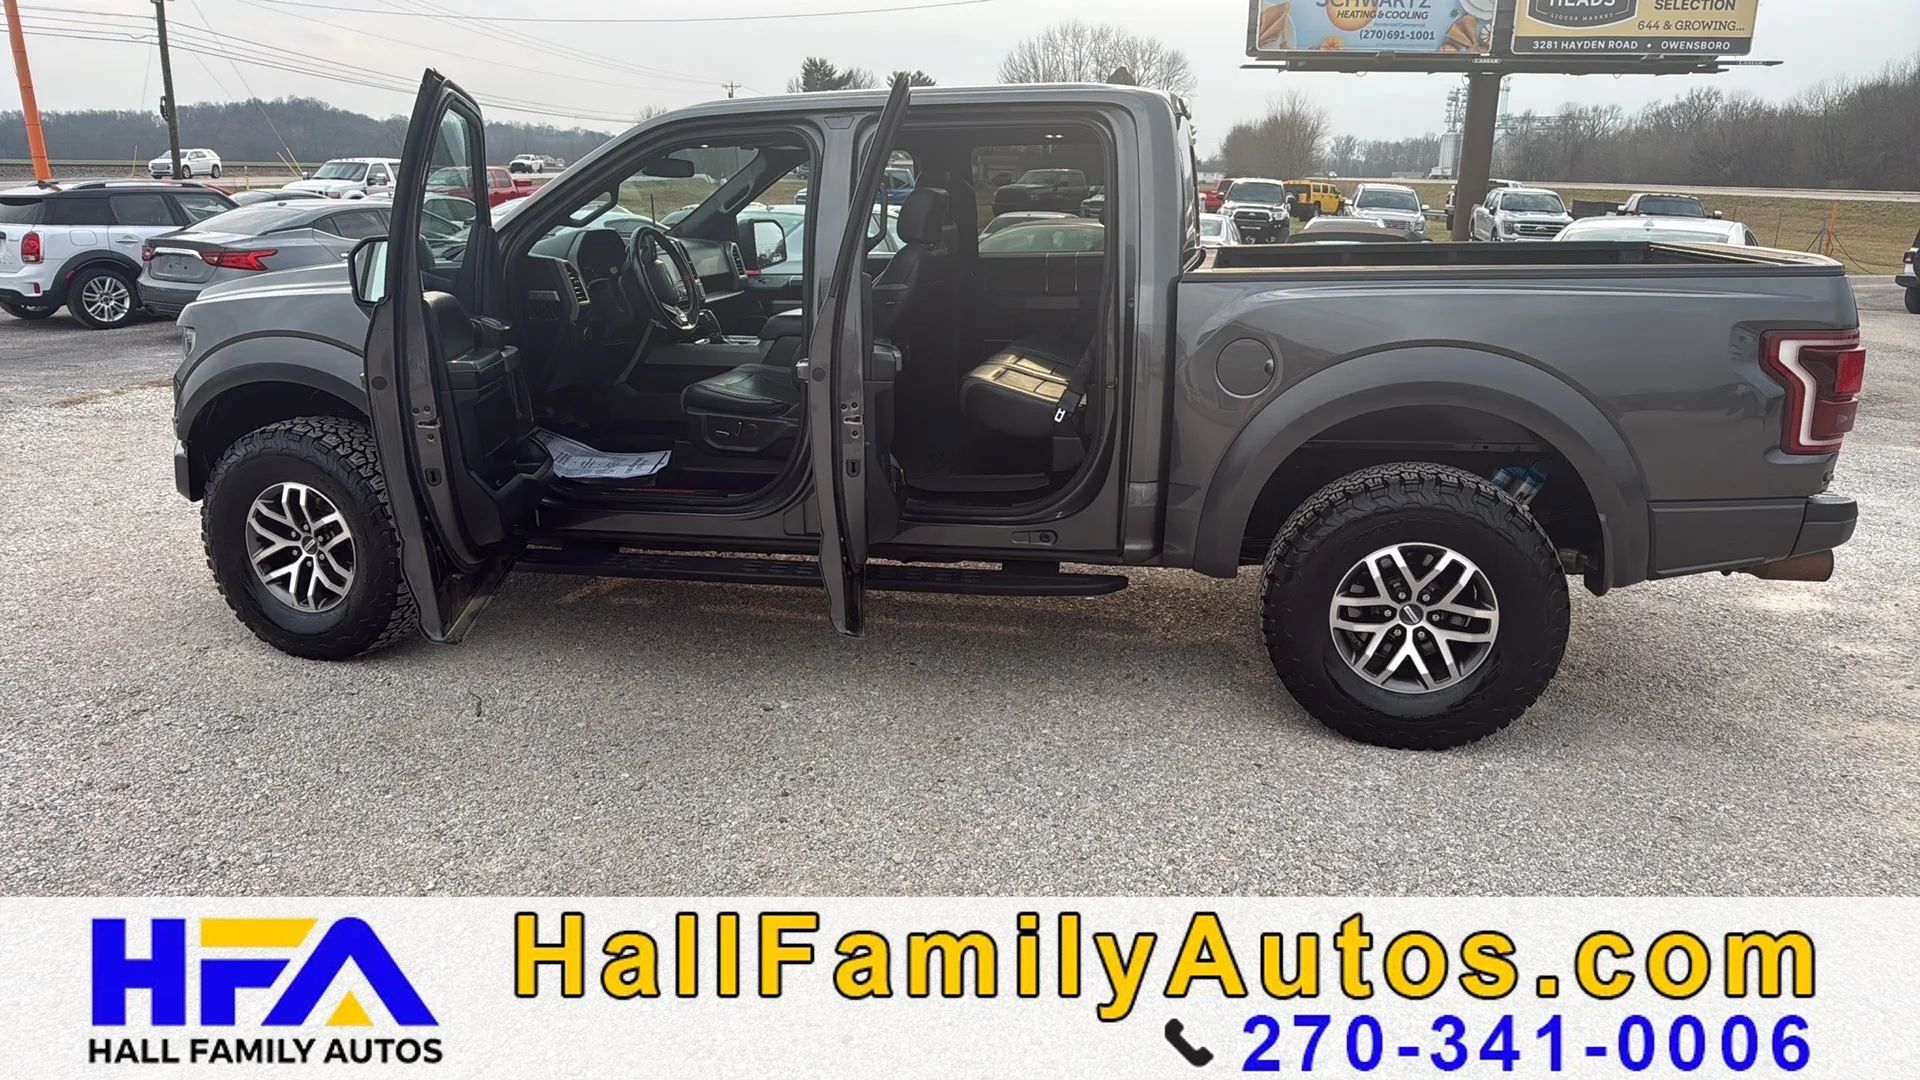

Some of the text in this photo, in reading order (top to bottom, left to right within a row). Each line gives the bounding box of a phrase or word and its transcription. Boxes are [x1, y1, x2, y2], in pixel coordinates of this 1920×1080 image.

[1654, 0, 1736, 11] SELECTION
[1336, 10, 1429, 20] HEATING & COOLING
[1582, 13, 1614, 21] MARKET
[1637, 21, 1745, 31] 644 & GROWING...
[1359, 30, 1436, 41] (270)691-1001
[1532, 40, 1731, 50] 3281 HAYDEN ROAD OWENSBORO
